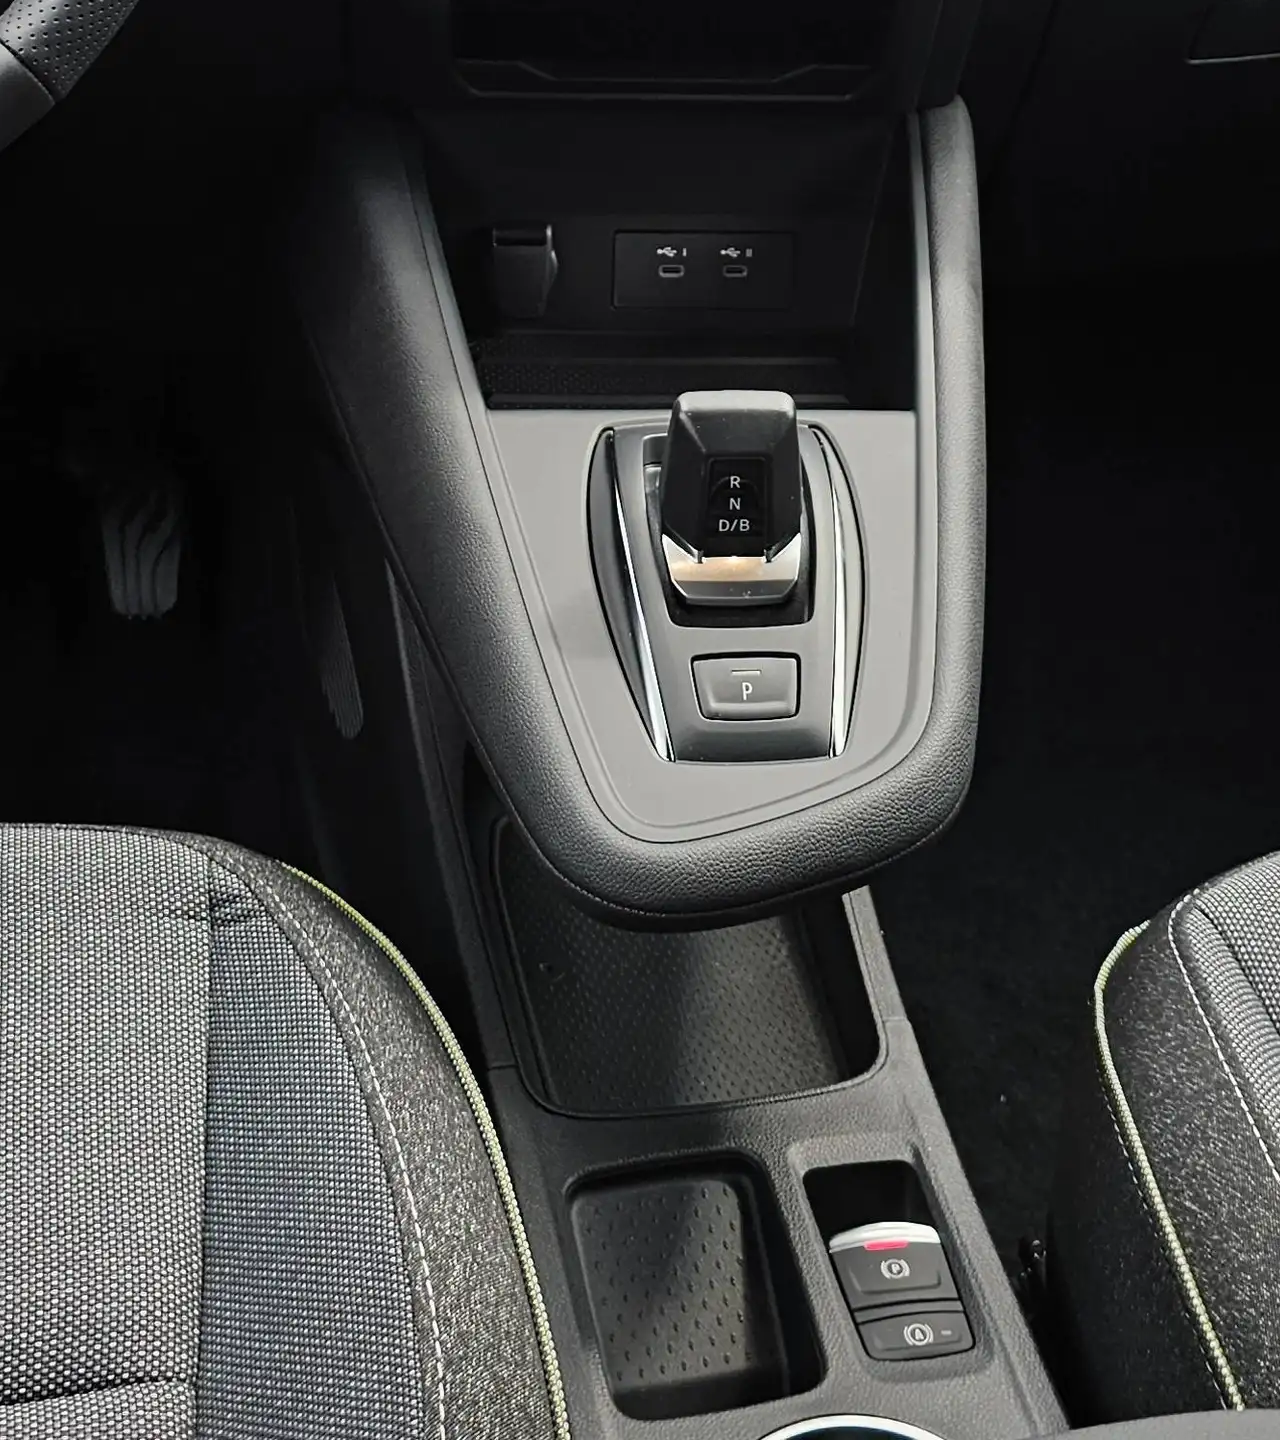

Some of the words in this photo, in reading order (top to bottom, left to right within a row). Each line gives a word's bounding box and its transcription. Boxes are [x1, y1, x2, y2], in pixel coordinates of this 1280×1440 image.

[730, 475, 741, 490] R
[729, 497, 741, 511] N
[718, 518, 751, 533] D/B
[741, 682, 754, 701] P
